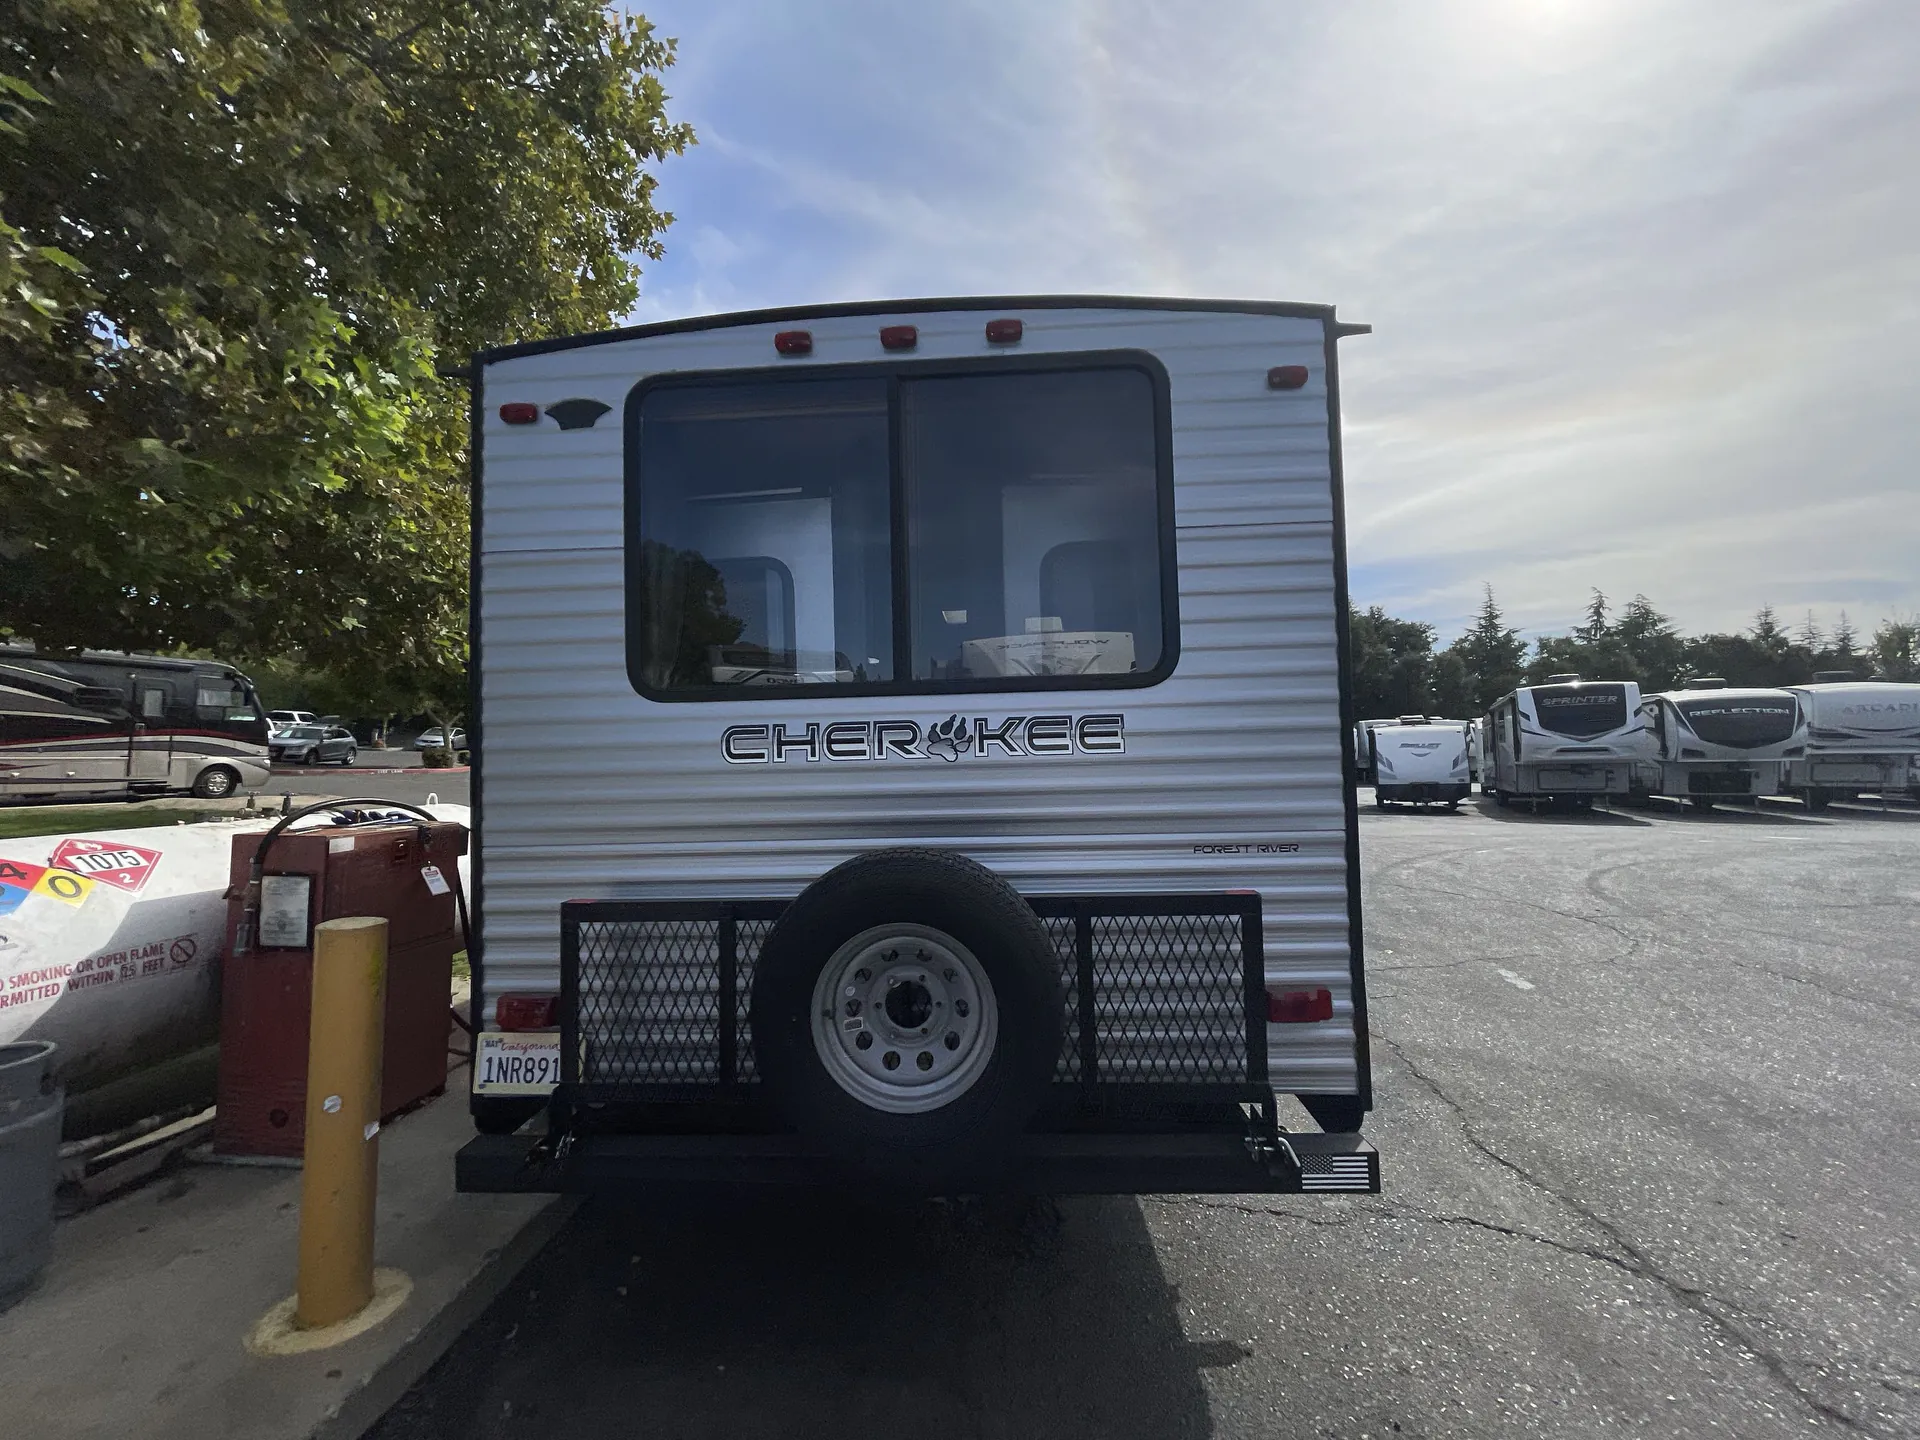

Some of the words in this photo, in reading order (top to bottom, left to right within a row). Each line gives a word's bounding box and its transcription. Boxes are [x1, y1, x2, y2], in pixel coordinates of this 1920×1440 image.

[1541, 695, 1618, 706] SPRINTER
[1689, 707, 1790, 717] REFLECTION
[1193, 844, 1252, 854] FOREST
[1257, 843, 1300, 853] RIVER
[76, 851, 141, 871] 1075
[118, 873, 134, 884] 2
[9, 963, 73, 989] SMOKING
[76, 958, 94, 974] OR
[97, 951, 127, 968] OPEN
[130, 942, 165, 961] FLAME
[67, 969, 114, 992] WITHIN
[142, 957, 165, 974] FEET
